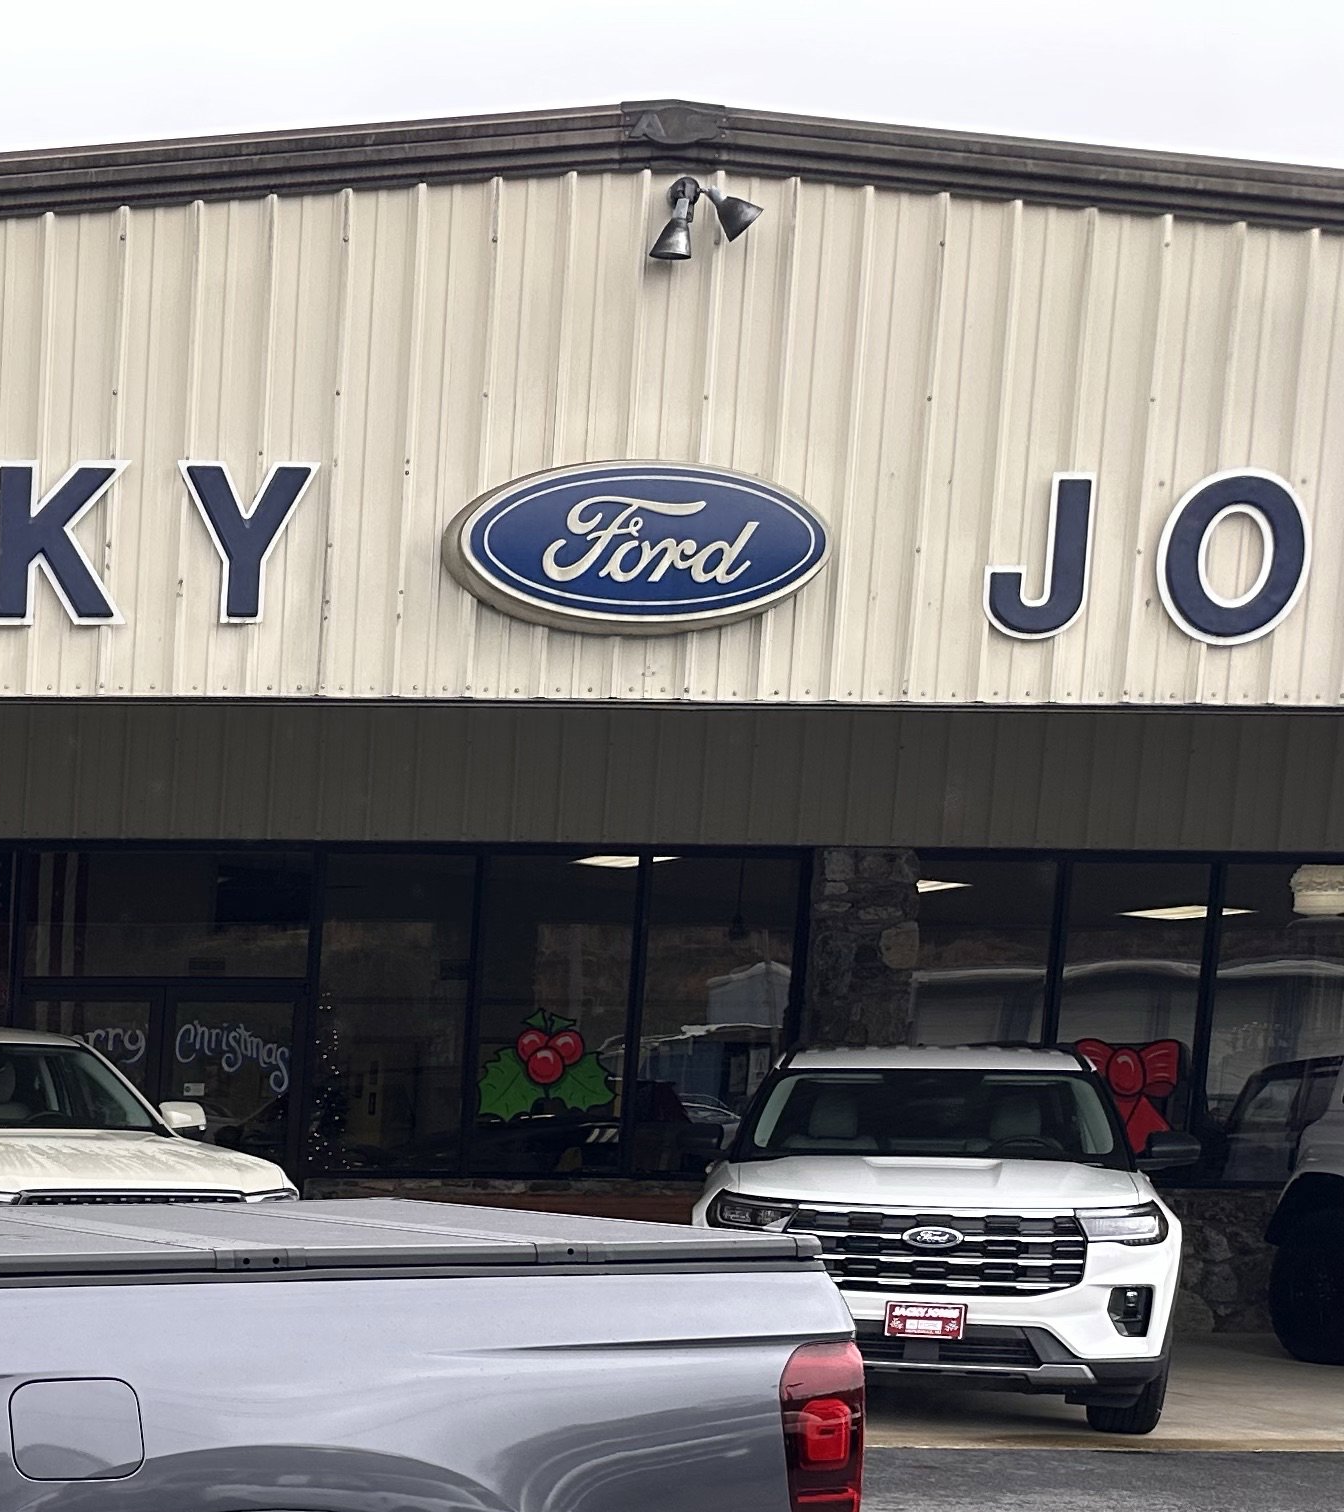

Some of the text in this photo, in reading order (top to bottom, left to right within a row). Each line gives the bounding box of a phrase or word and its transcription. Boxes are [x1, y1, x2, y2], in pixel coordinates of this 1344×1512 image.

[542, 495, 761, 586] Ford
[984, 467, 1312, 646] JO
[175, 1020, 289, 1093] Christmas
[916, 1230, 950, 1243] Ford
